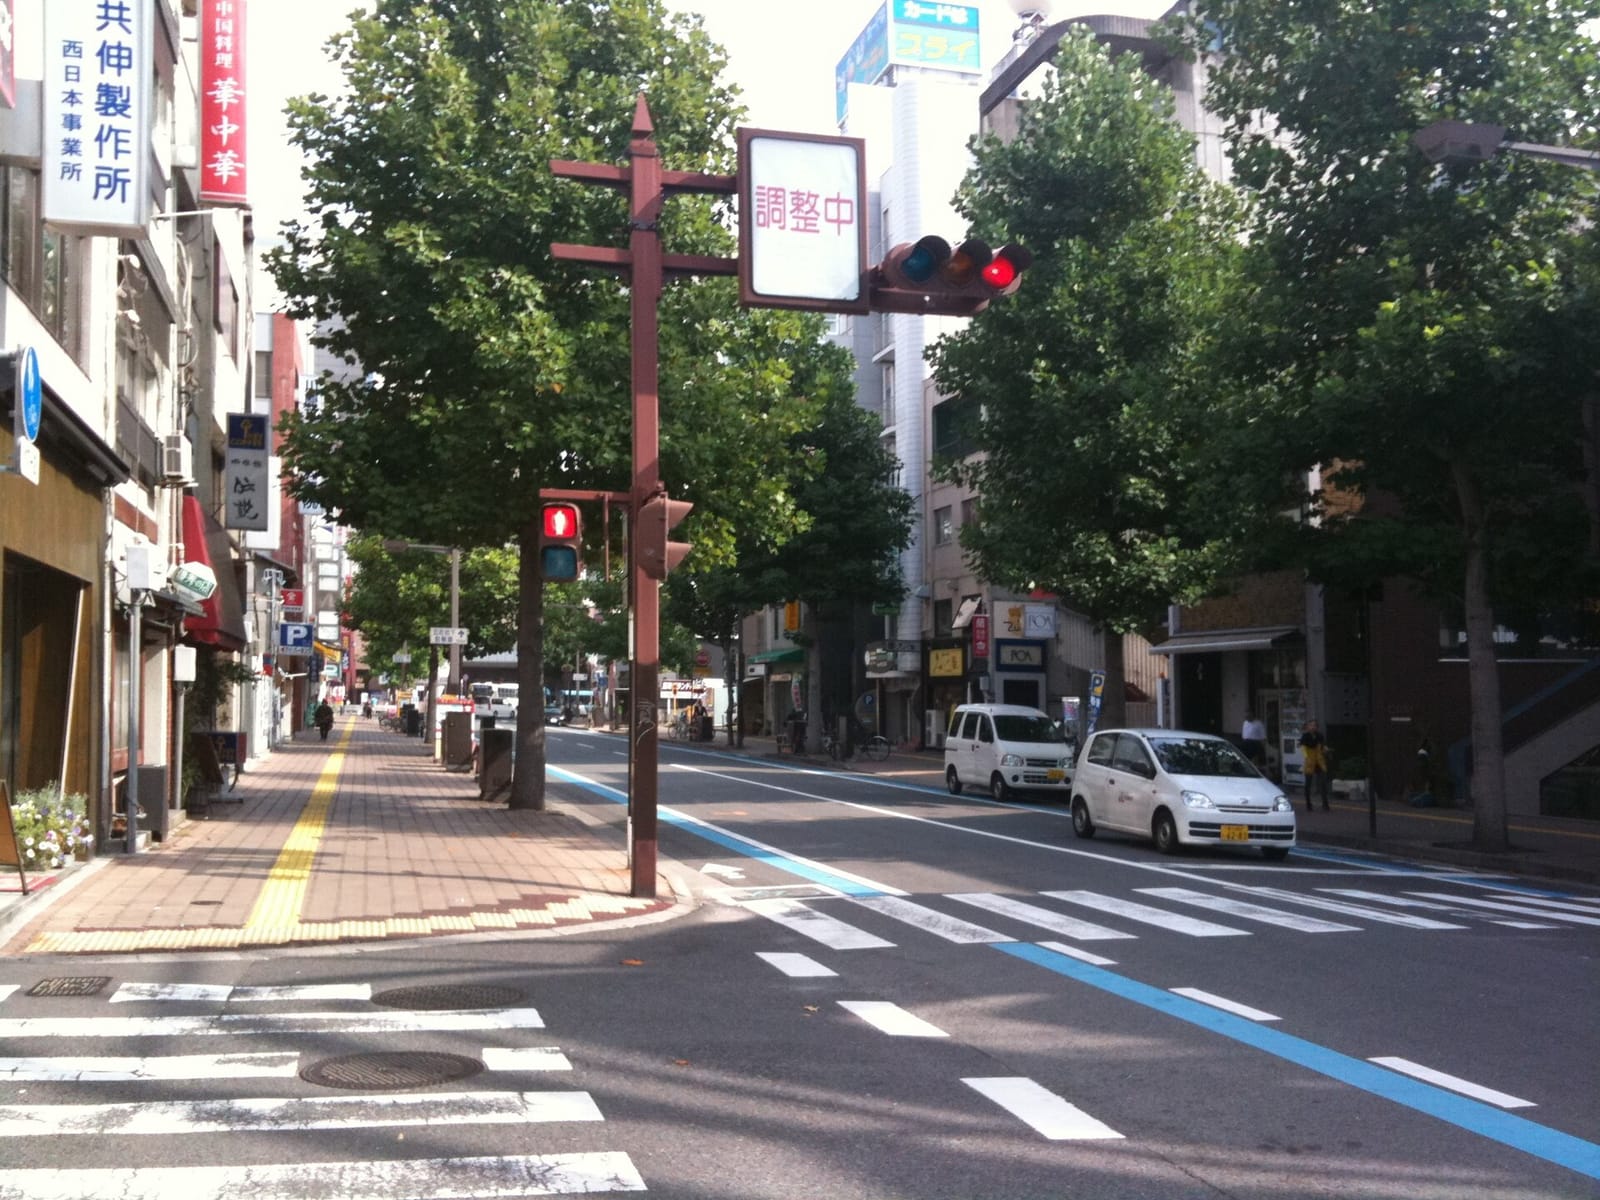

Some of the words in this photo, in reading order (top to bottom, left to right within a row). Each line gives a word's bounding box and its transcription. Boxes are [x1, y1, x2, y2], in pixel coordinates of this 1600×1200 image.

[214, 0, 233, 69] 中国料理
[60, 39, 84, 182] 西日本事業所
[93, 0, 133, 204] 共伸製作所
[206, 77, 245, 185] 華中華
[754, 185, 854, 236] 調整中
[286, 625, 308, 646] P
